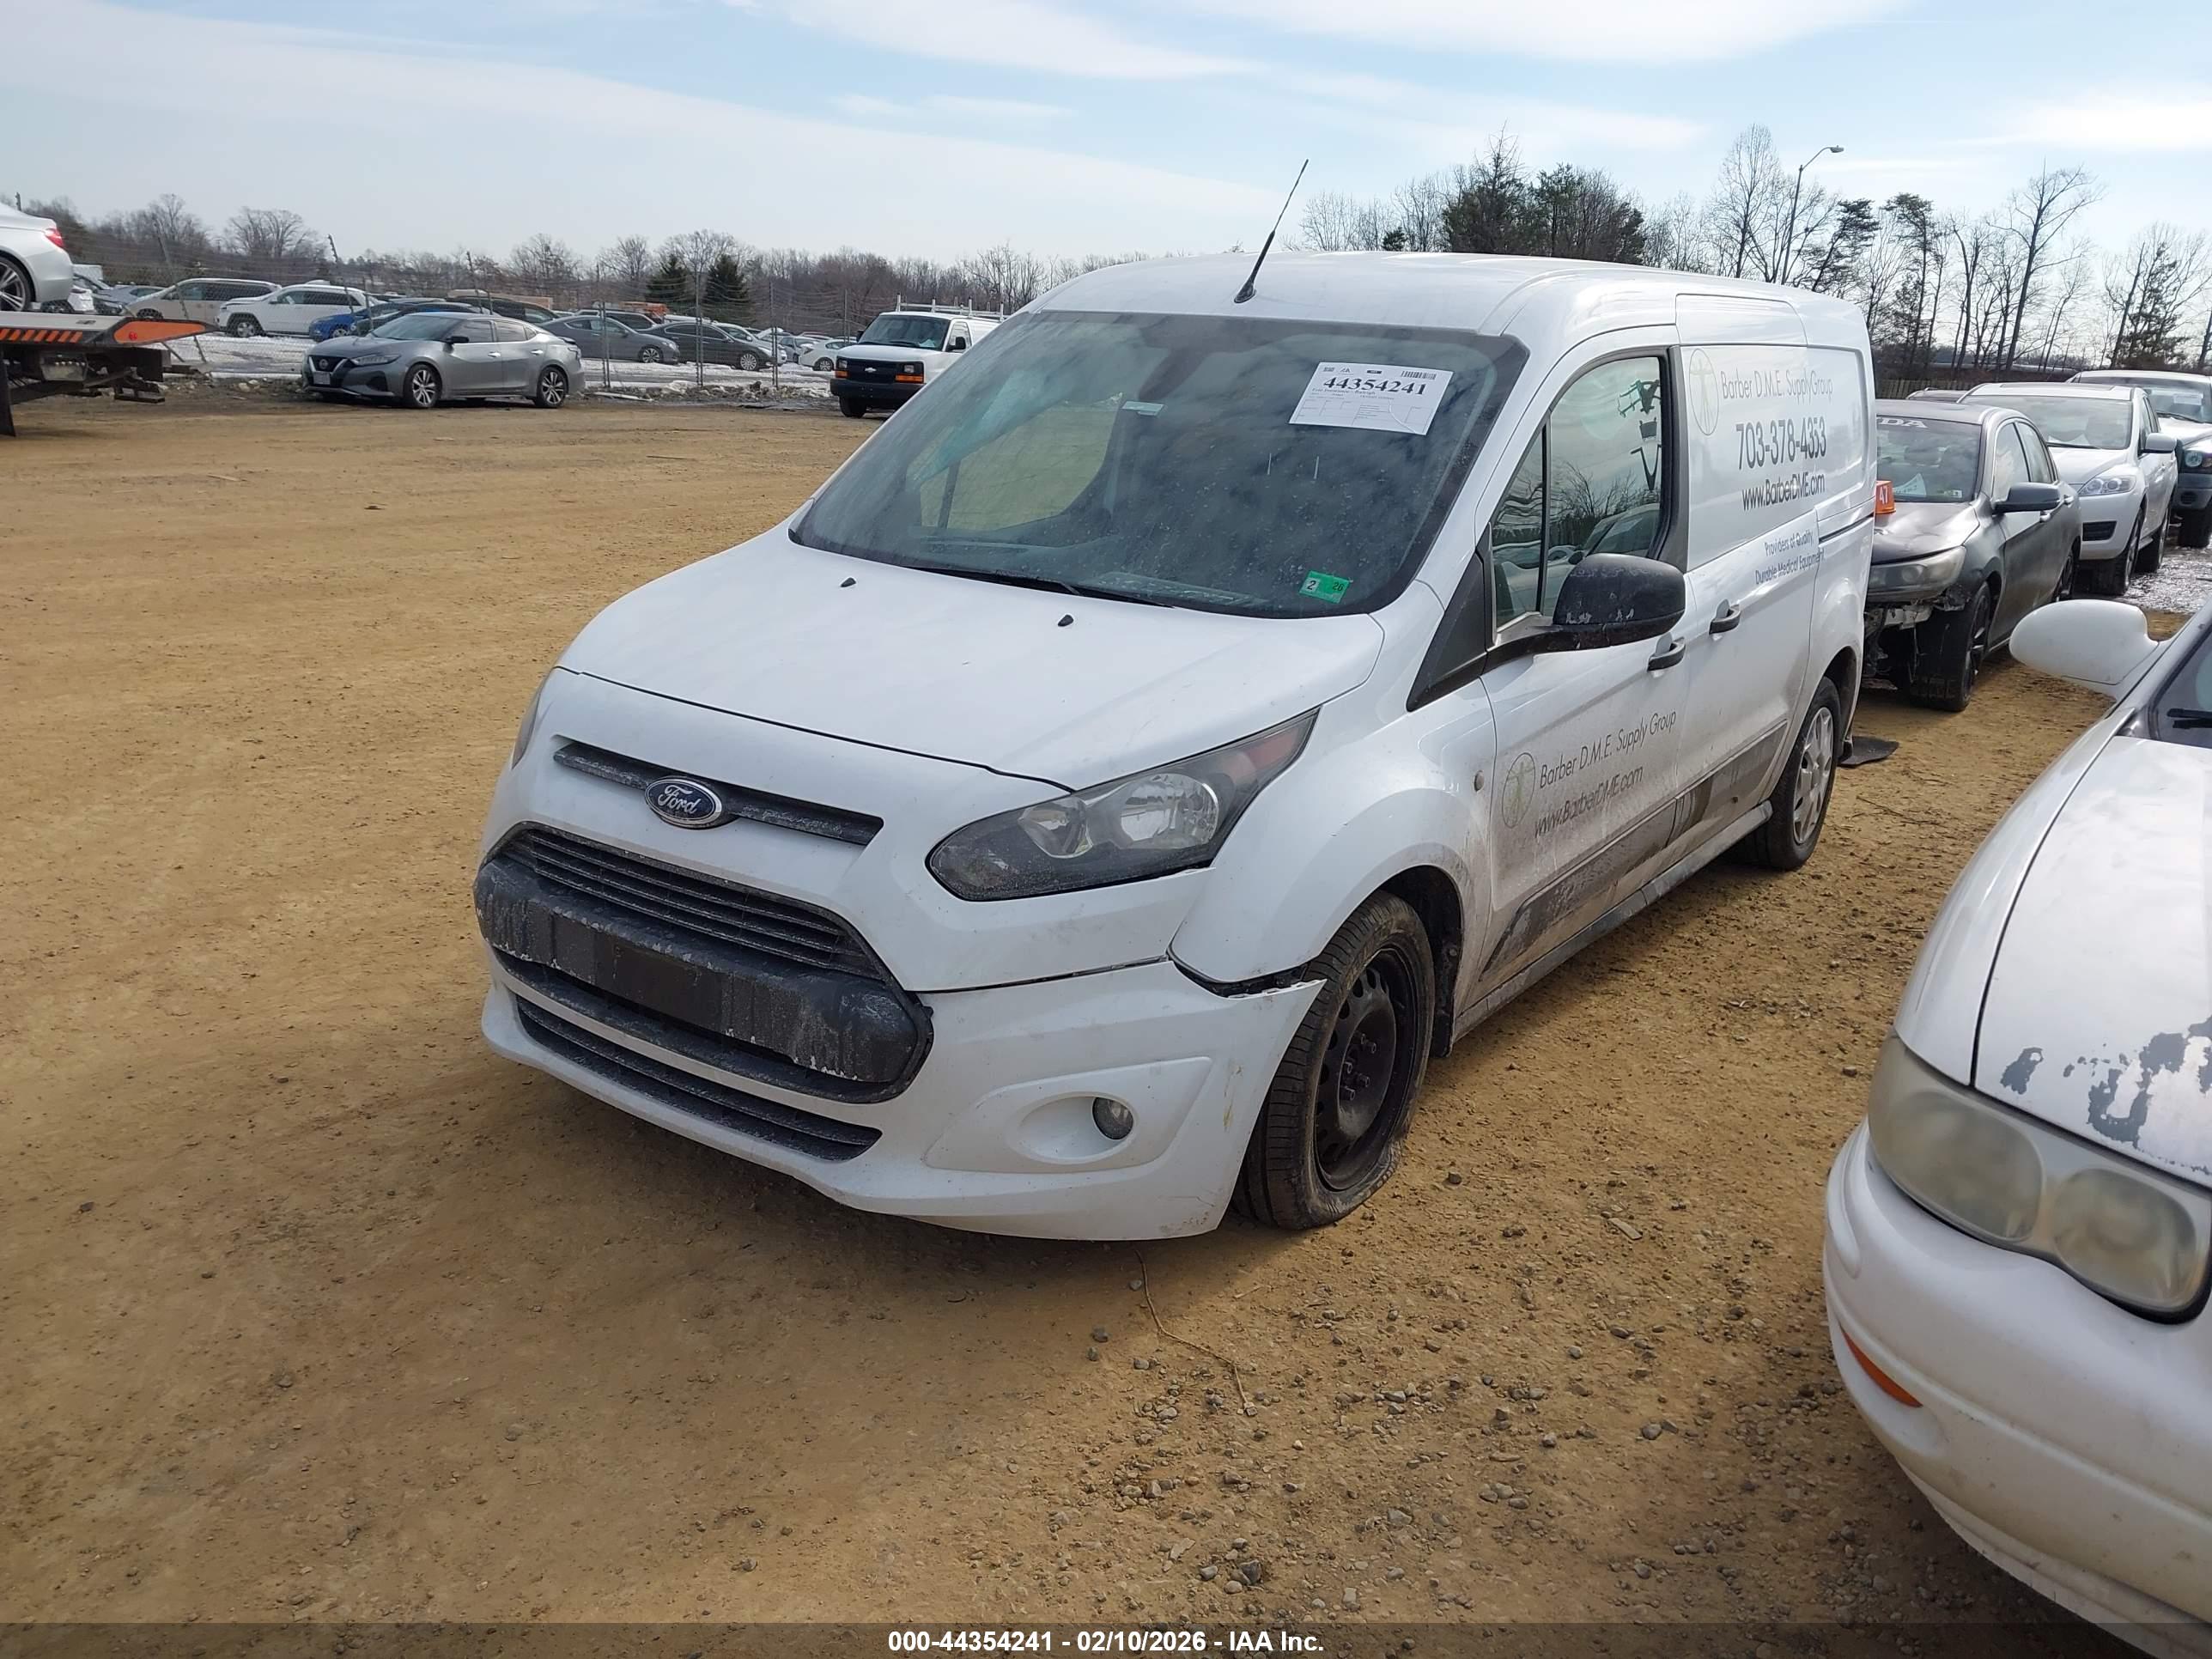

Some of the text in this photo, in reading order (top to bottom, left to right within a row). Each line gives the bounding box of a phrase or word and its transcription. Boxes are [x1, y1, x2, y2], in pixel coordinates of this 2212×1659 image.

[1323, 376, 1427, 395] 44354241
[1720, 368, 1753, 399] Barber
[1786, 368, 1811, 405] Supply
[1810, 369, 1833, 403] Group
[1735, 416, 1827, 471] 703-378-4353
[1765, 538, 1790, 556] Providers
[1755, 547, 1825, 585] Durable Medical Equipment
[1307, 580, 1316, 591] 2
[1540, 711, 1677, 788] Barber D.M.E. Supply Group
[657, 785, 702, 814] Ford
